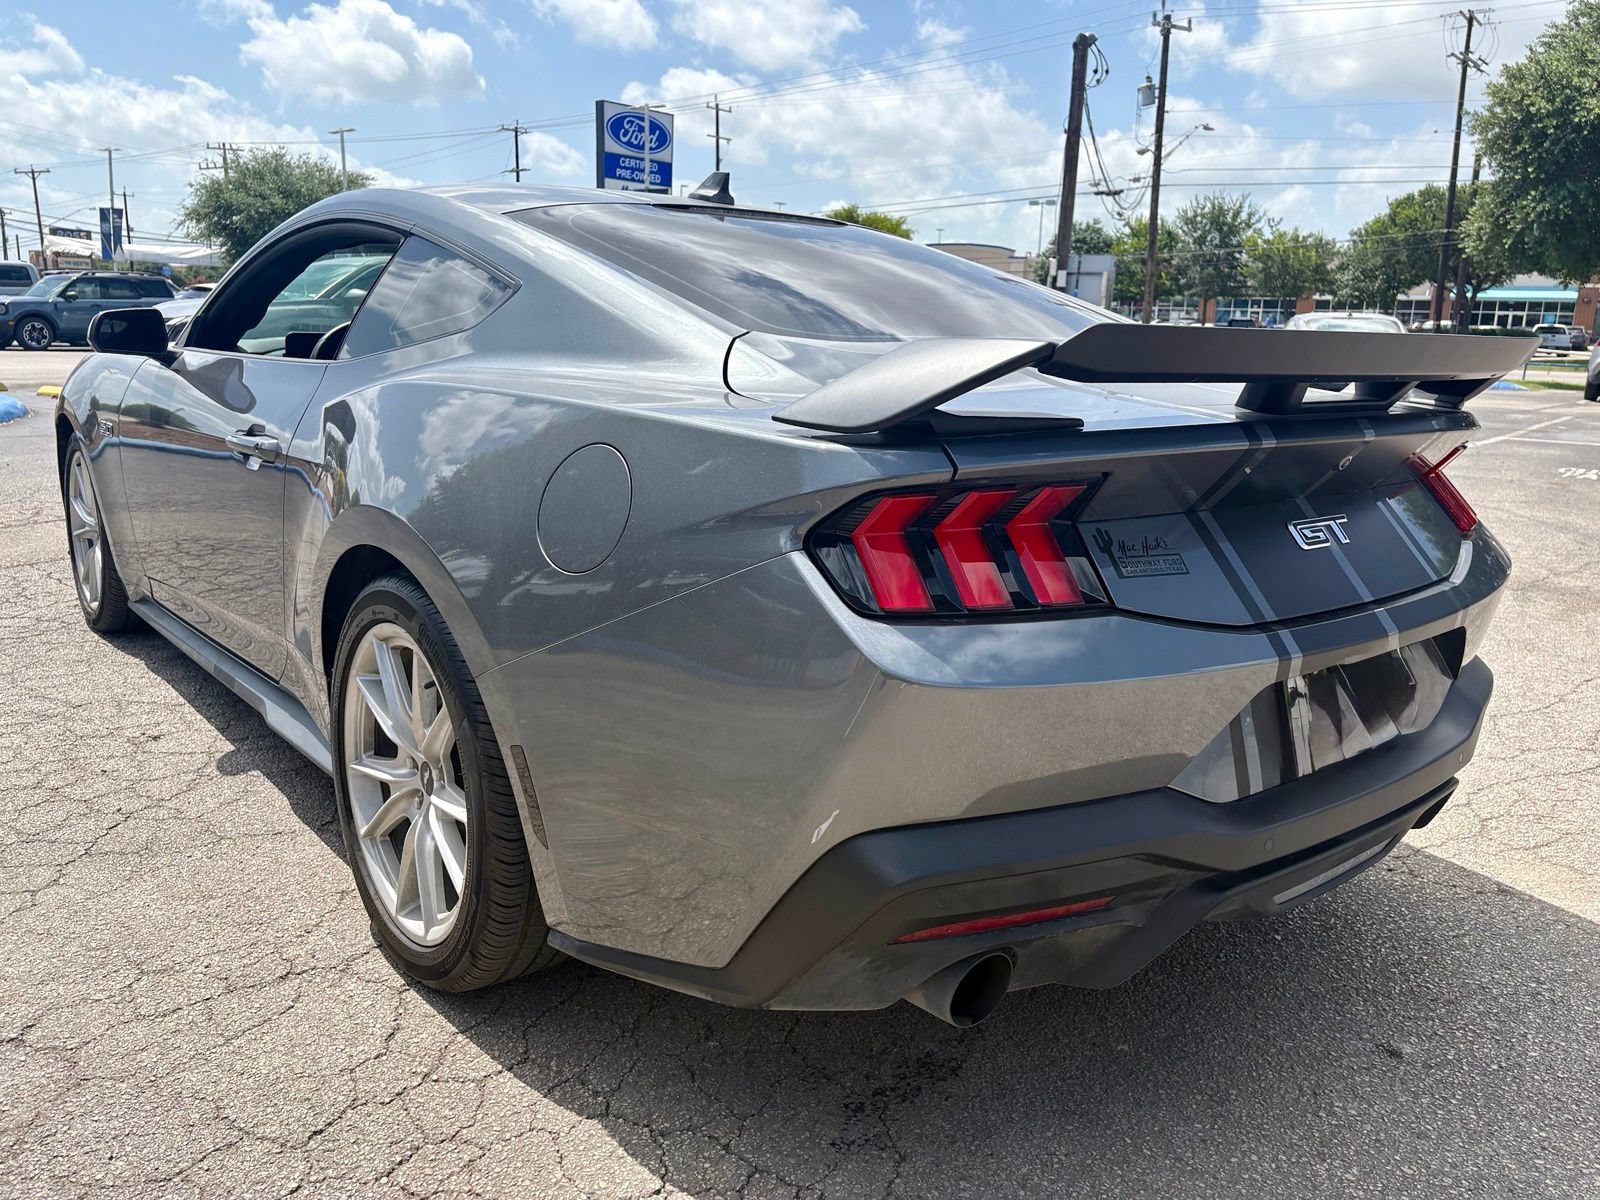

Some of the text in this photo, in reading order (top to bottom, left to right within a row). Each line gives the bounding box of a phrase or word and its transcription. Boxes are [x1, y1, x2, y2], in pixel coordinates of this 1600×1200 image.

[619, 117, 660, 149] Ford
[619, 157, 659, 172] CERTIFED
[615, 168, 662, 183] PRE-OWED
[1286, 514, 1350, 550] GT
[1117, 539, 1137, 560] Mac
[1118, 556, 1183, 569] SOUTHWAY FORD
[1126, 568, 1139, 576] SAN
